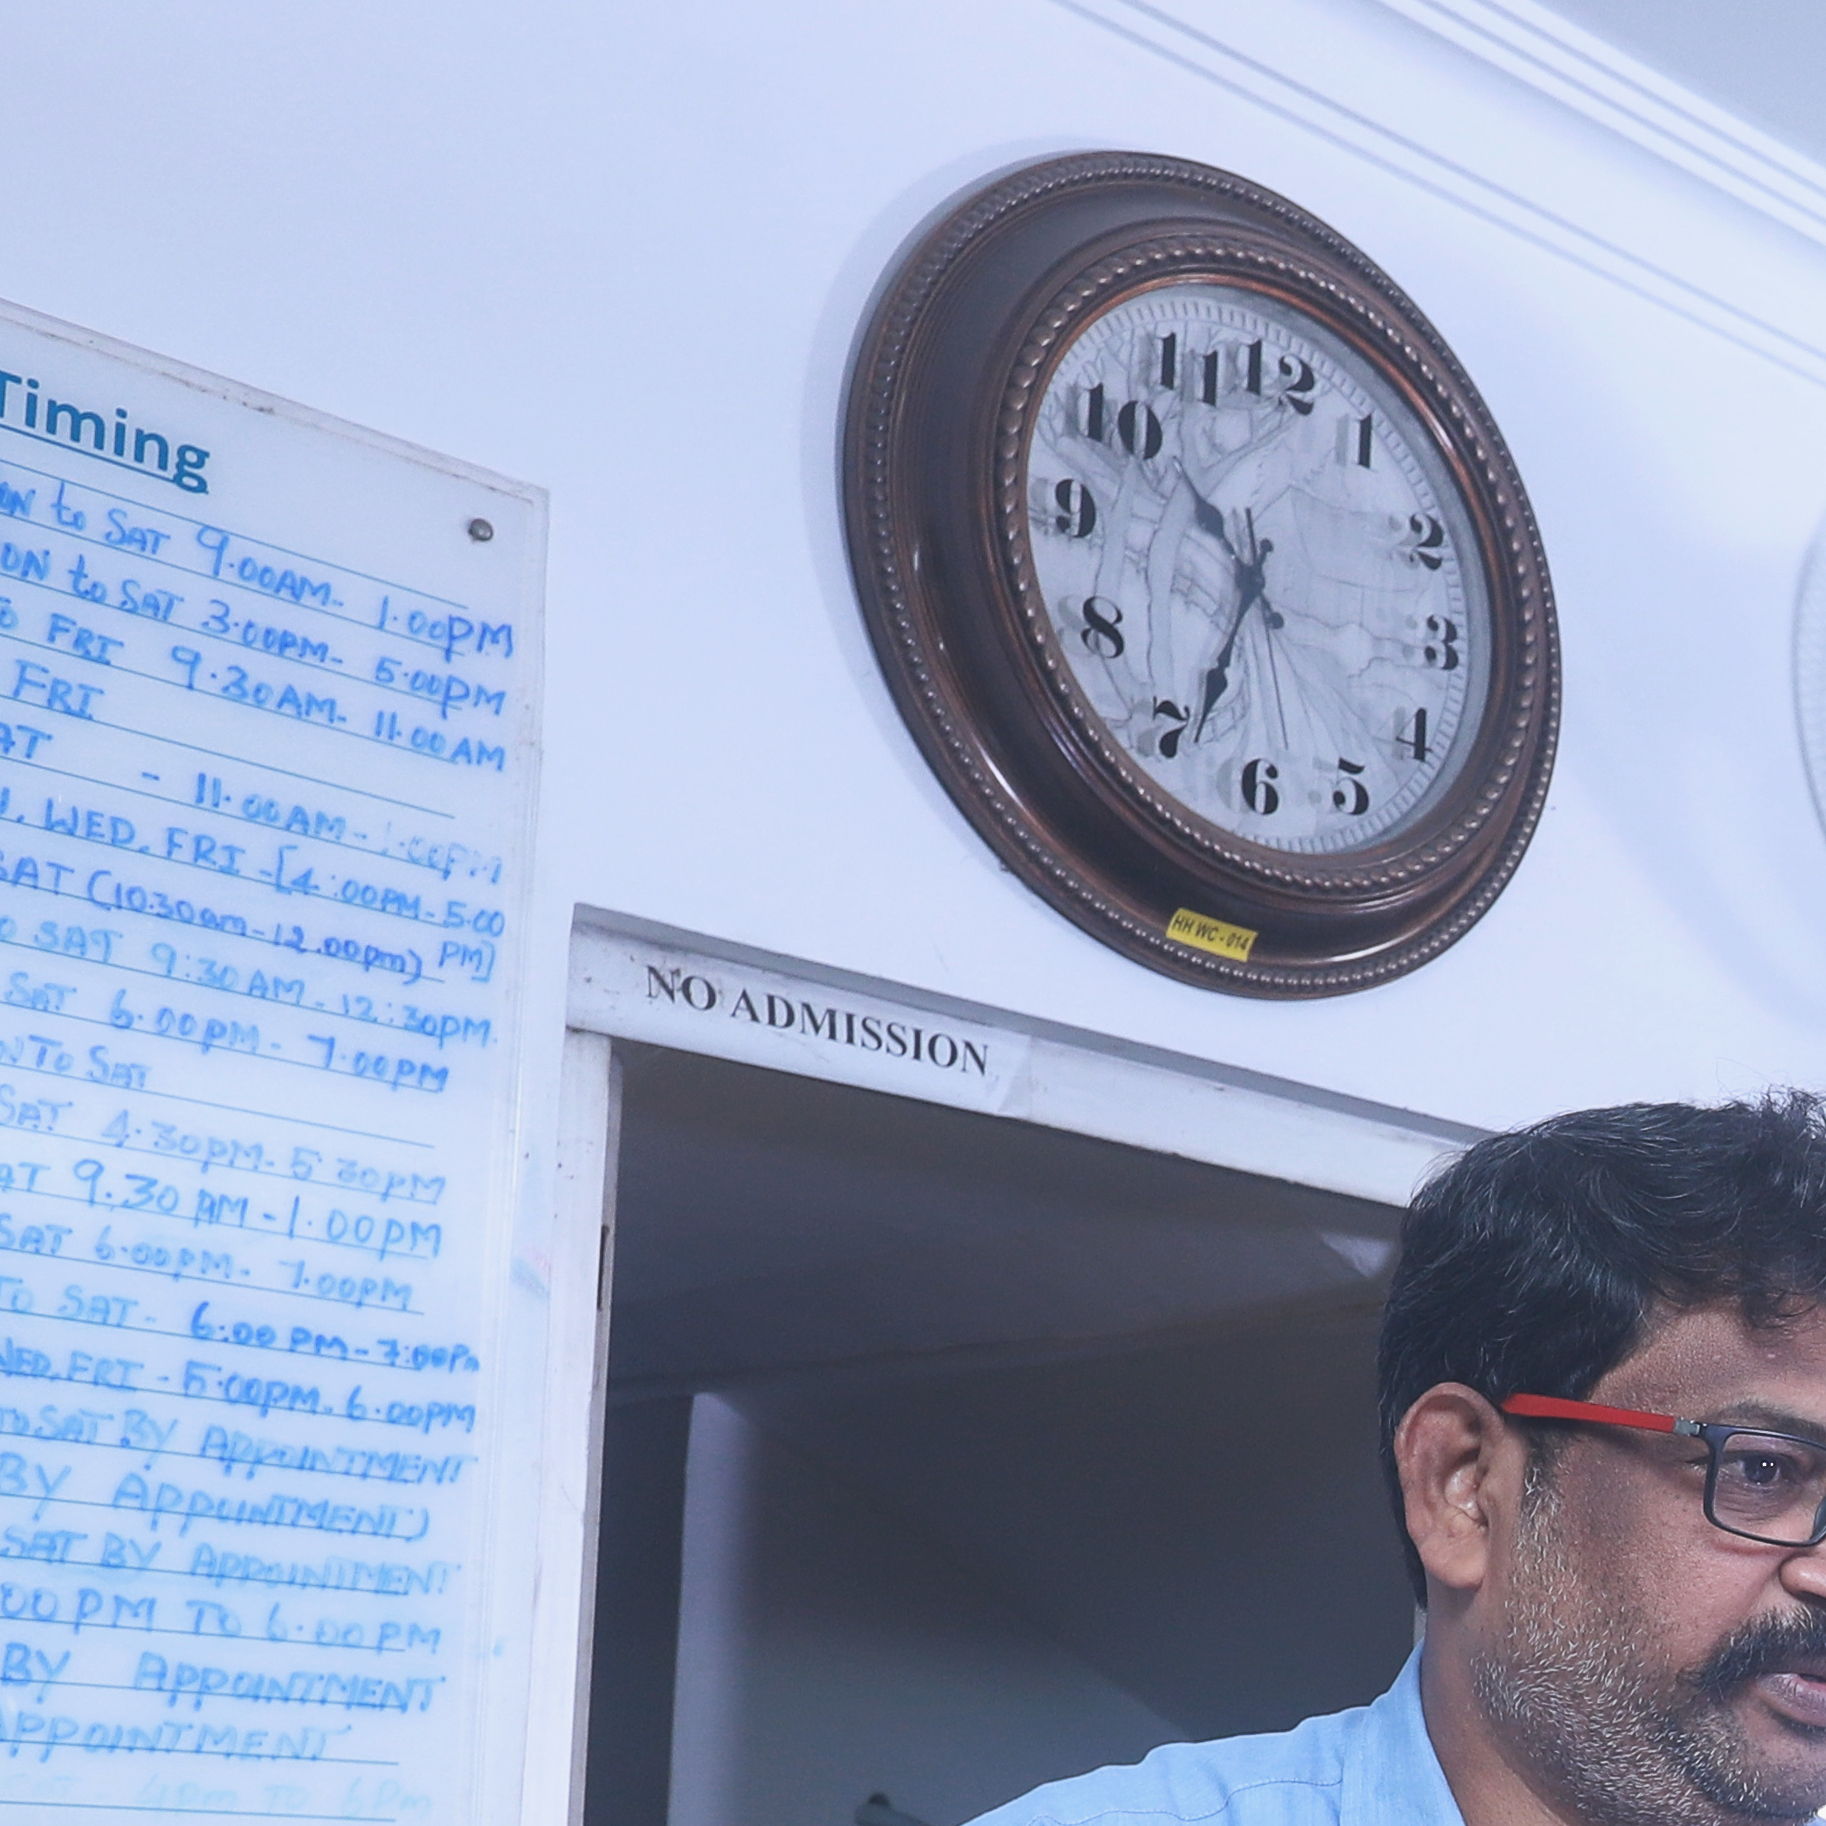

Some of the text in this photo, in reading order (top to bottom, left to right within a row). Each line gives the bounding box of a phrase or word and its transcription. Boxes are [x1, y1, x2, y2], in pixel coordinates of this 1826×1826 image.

[1160, 332, 1217, 406] 11
[1246, 340, 1315, 416] 12
[1084, 382, 1163, 460] 10
[1355, 413, 1373, 469] 1
[1055, 478, 1096, 539] 9
[1409, 512, 1443, 570] 2
[47, 613, 125, 666] FRI
[1081, 596, 1124, 659] 8
[1424, 614, 1458, 670] 3
[1152, 696, 1189, 759] 7
[1395, 707, 1431, 762] 4
[1240, 757, 1279, 815] 6
[1332, 757, 1369, 815] 5
[646, 965, 990, 1076] NO ADMISSION
